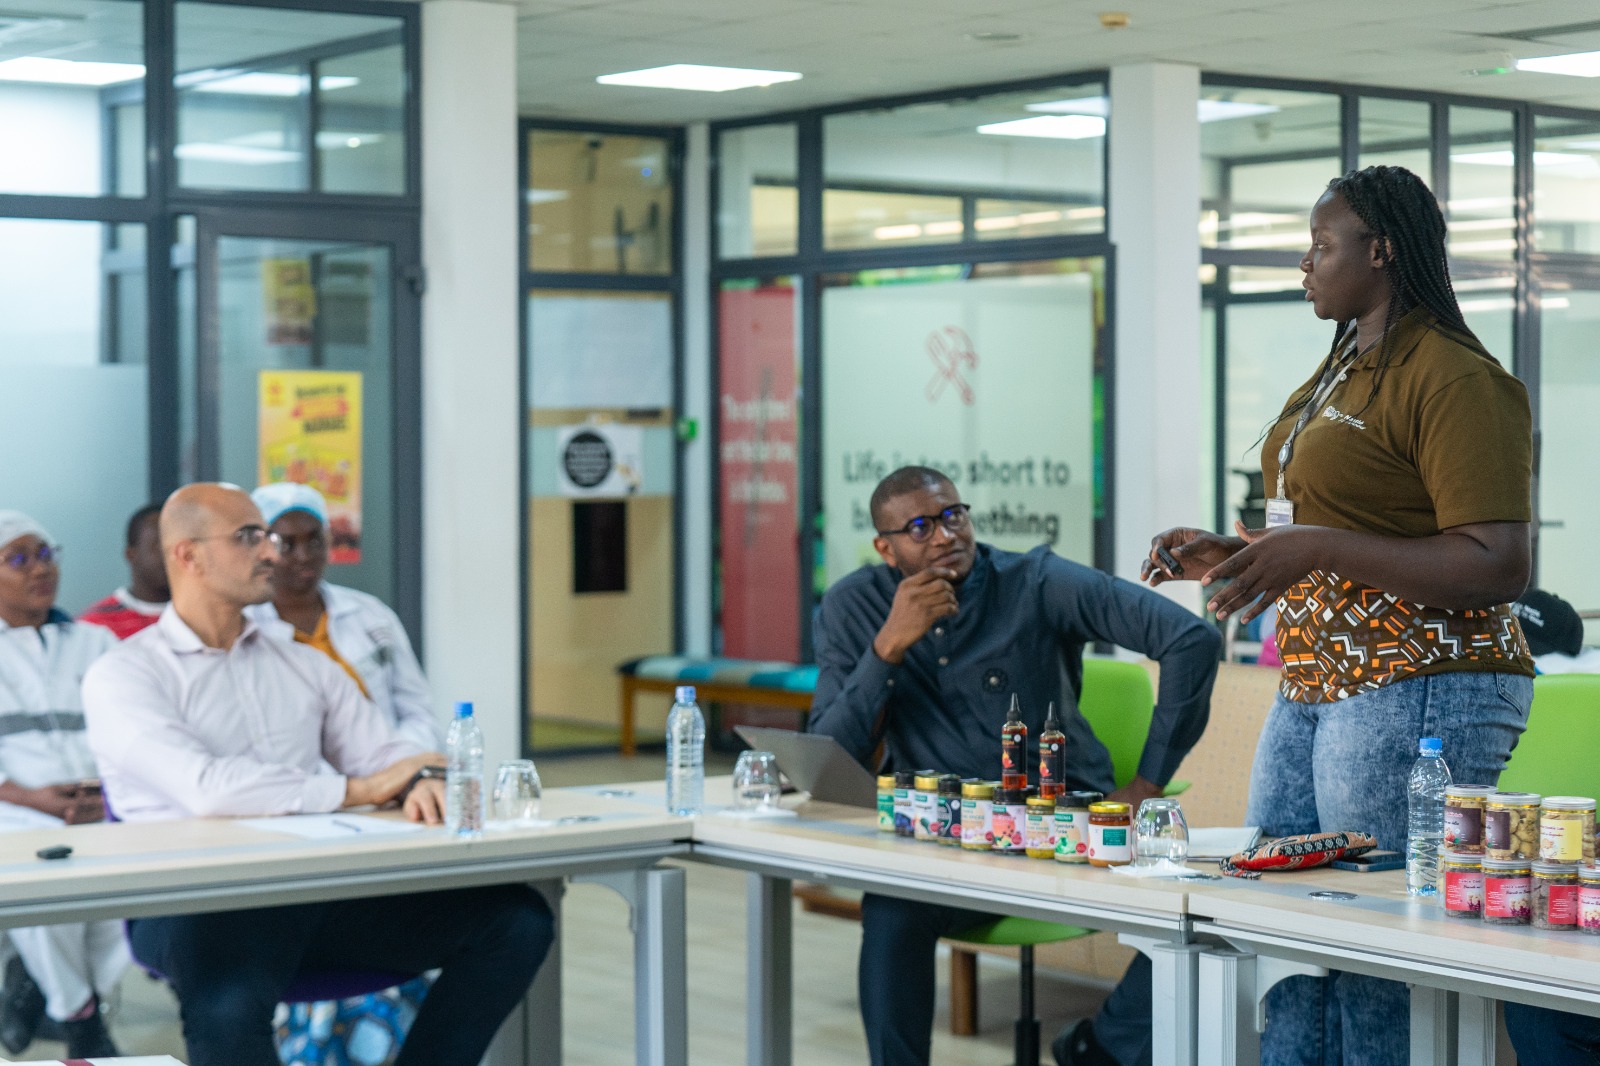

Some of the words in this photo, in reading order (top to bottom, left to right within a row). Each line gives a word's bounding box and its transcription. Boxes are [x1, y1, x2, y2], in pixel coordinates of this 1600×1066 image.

[843, 450, 889, 483] Life
[968, 451, 1035, 486] short
[1043, 459, 1071, 487] to
